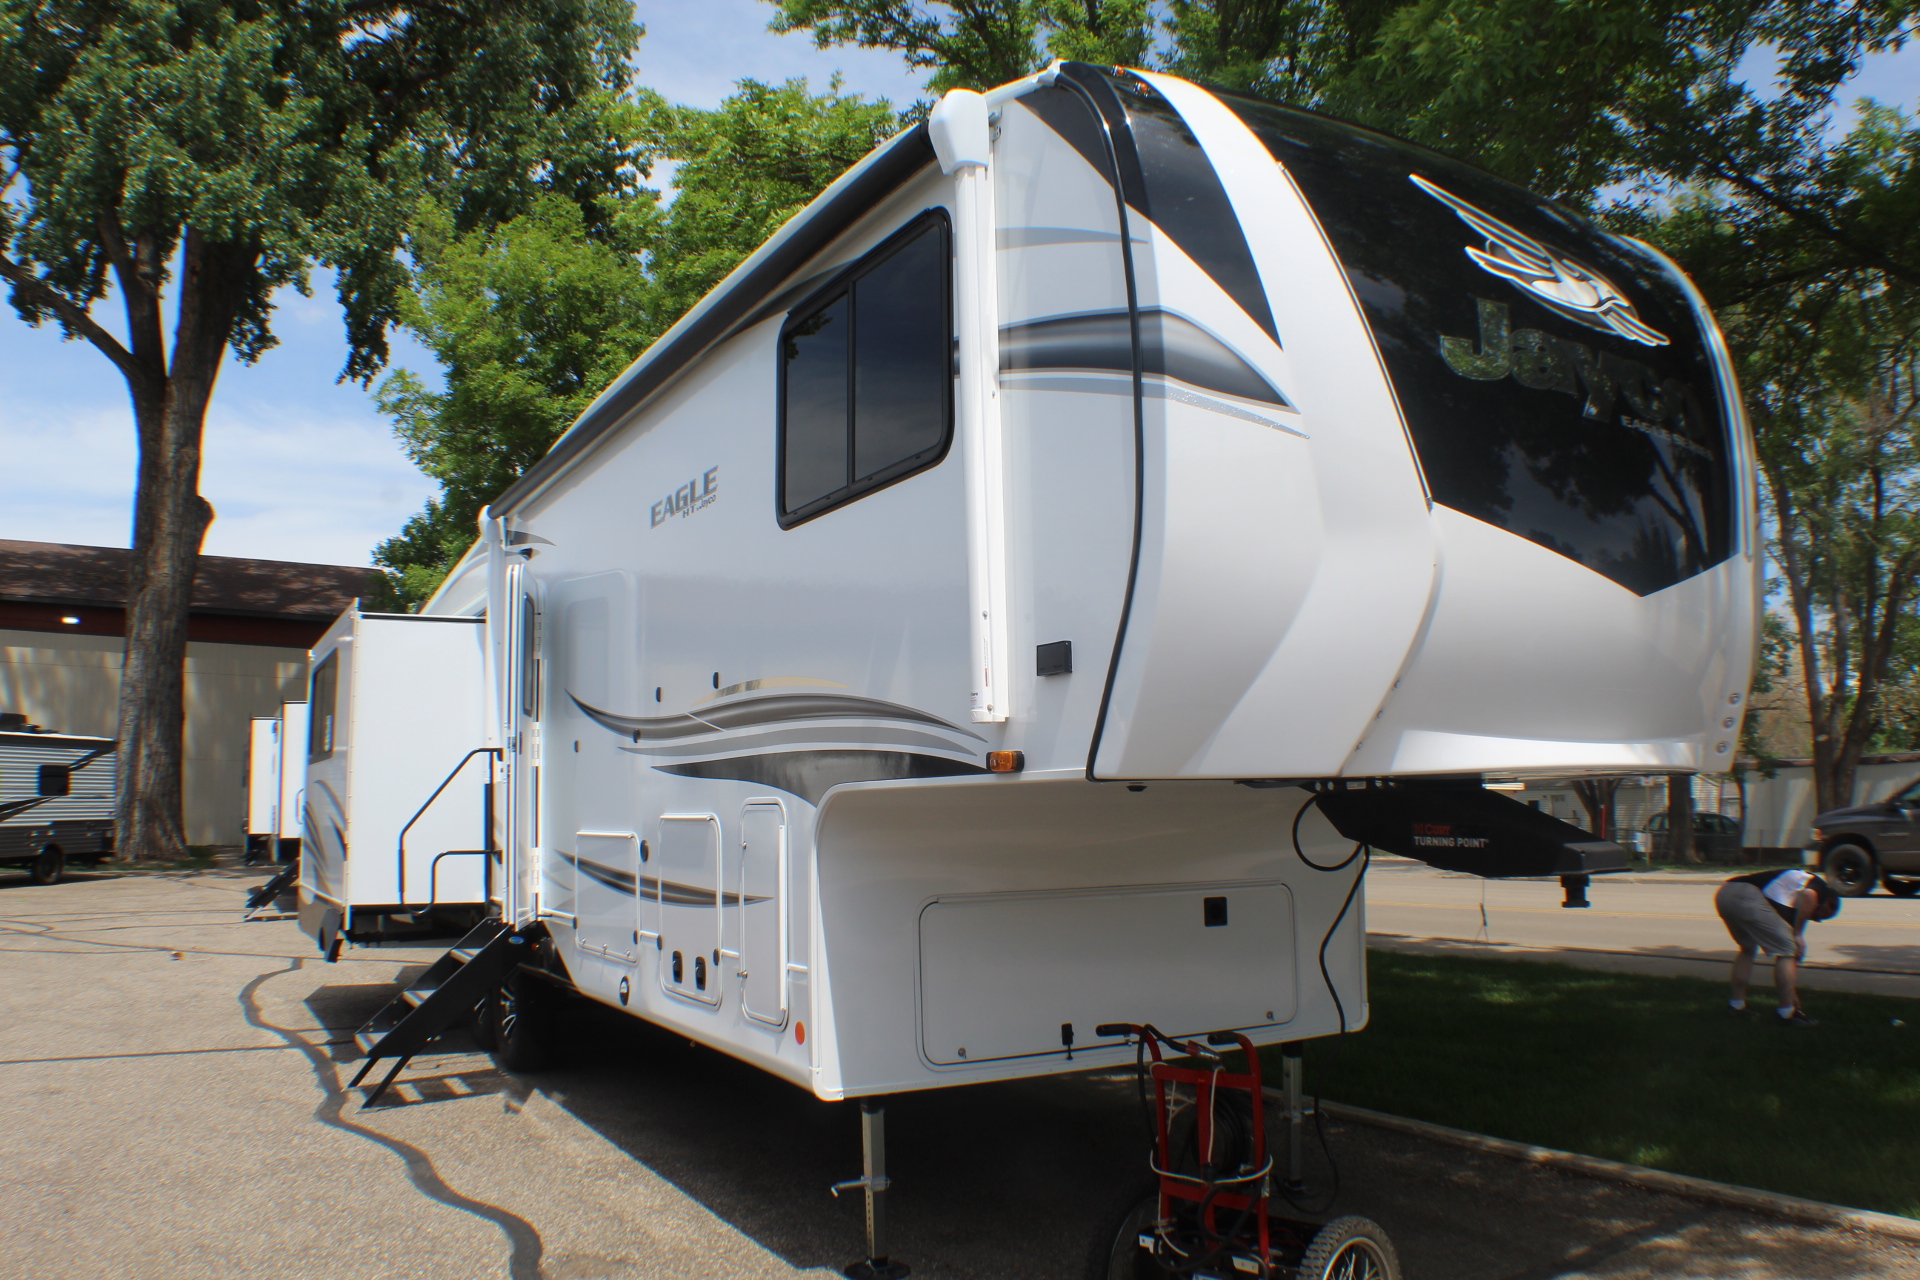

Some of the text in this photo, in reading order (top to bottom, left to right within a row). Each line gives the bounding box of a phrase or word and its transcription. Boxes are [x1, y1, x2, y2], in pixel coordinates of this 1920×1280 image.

[650, 464, 719, 528] EAGLE
[1413, 836, 1486, 848] TURNING POINT
